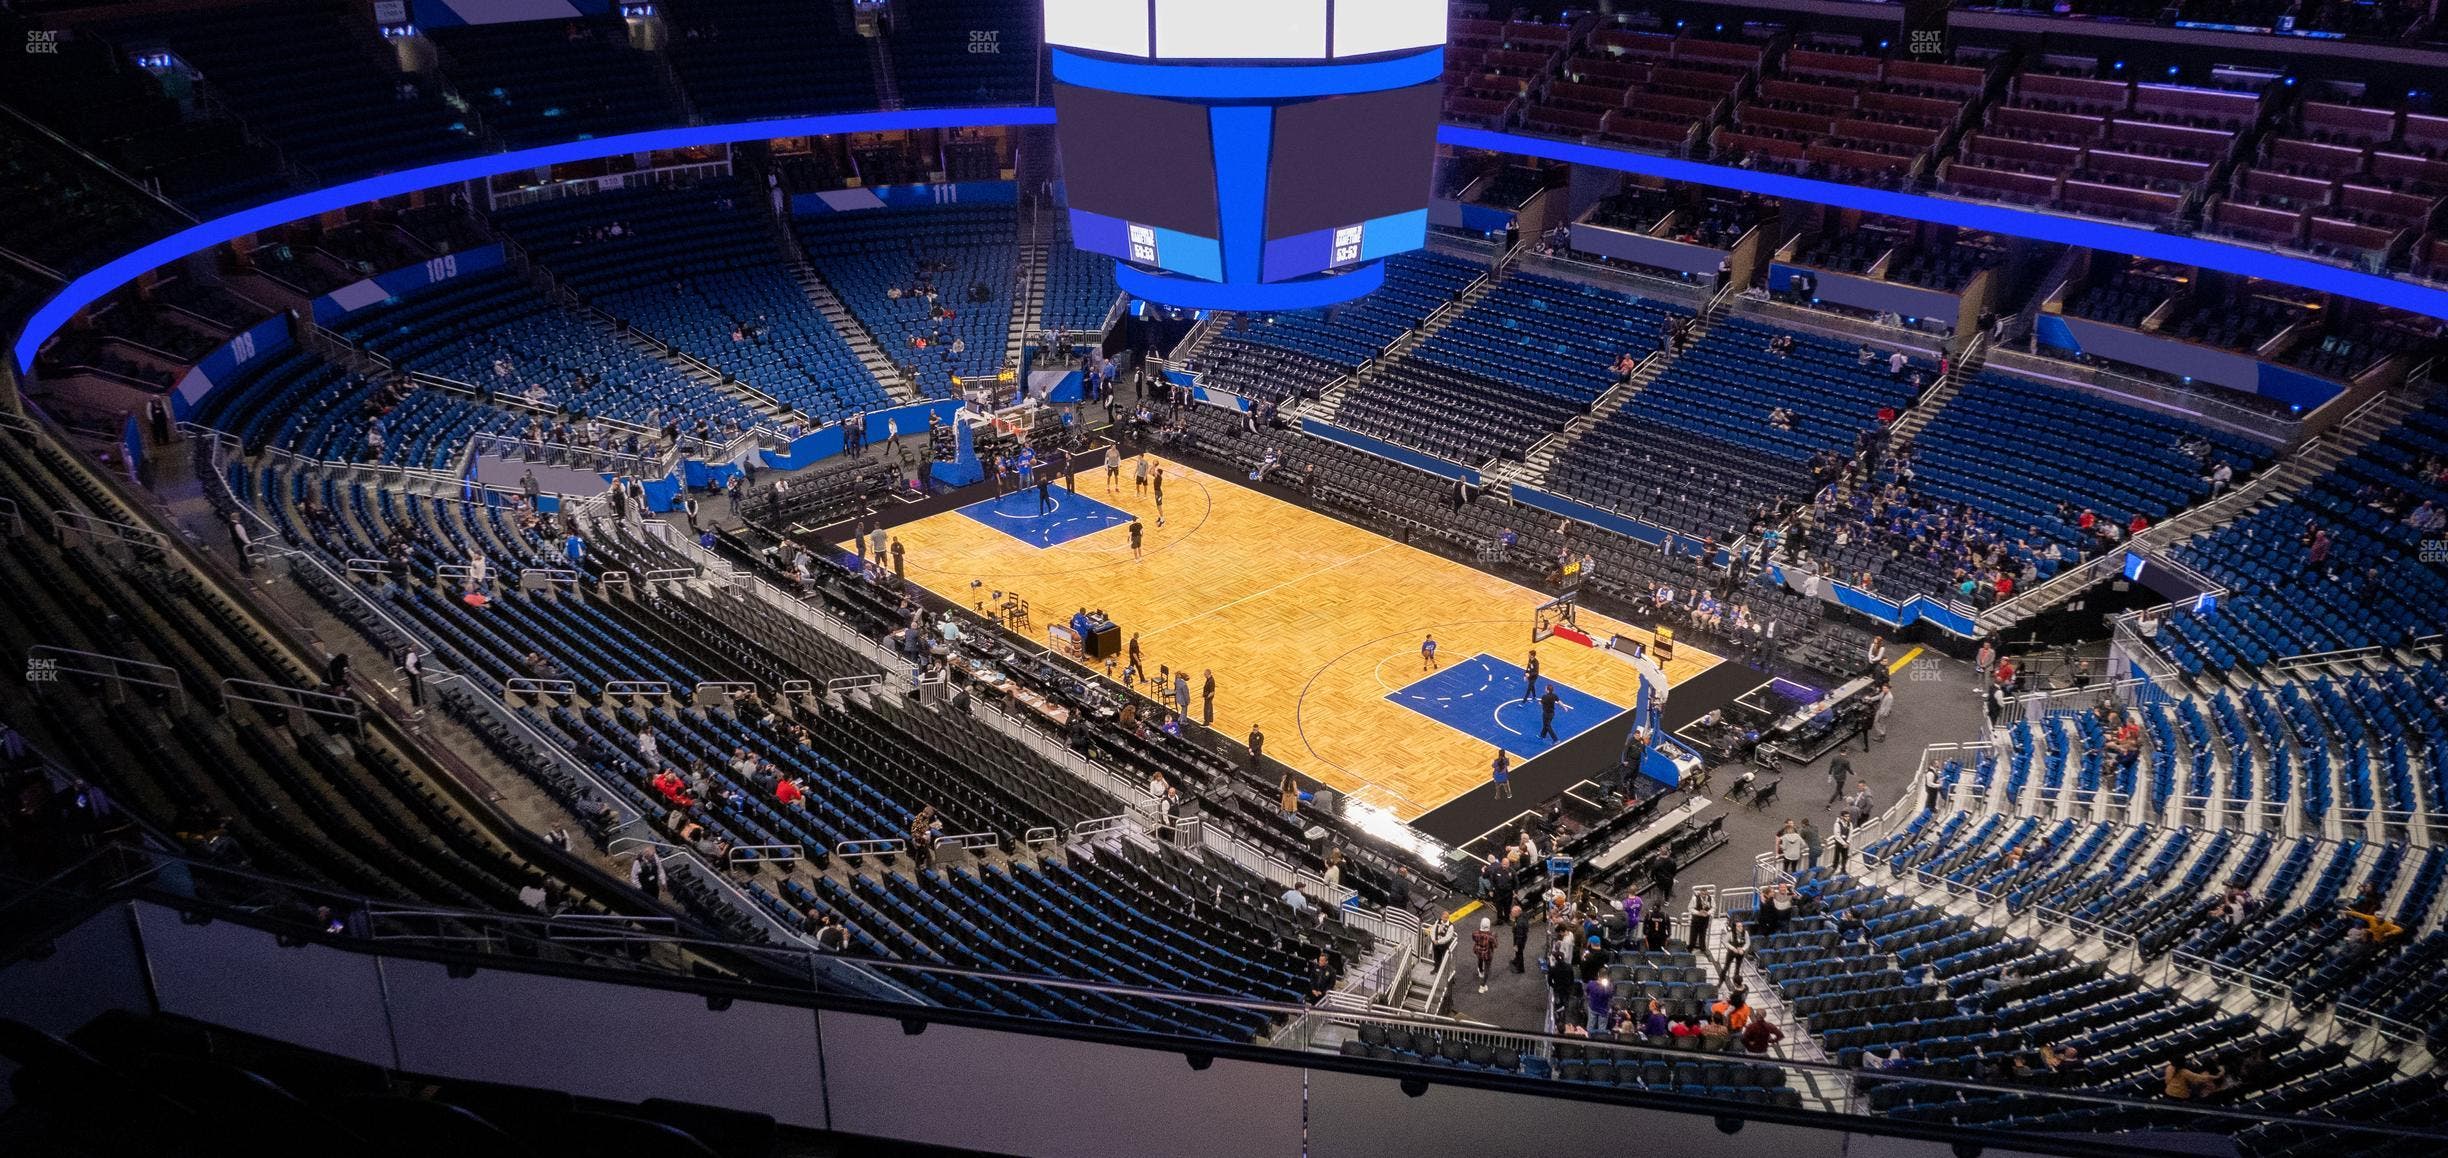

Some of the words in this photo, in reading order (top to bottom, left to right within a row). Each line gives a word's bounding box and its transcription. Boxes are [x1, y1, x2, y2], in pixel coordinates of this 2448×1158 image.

[933, 183, 957, 205] 111
[426, 254, 457, 283] 109
[231, 331, 256, 366] 108
